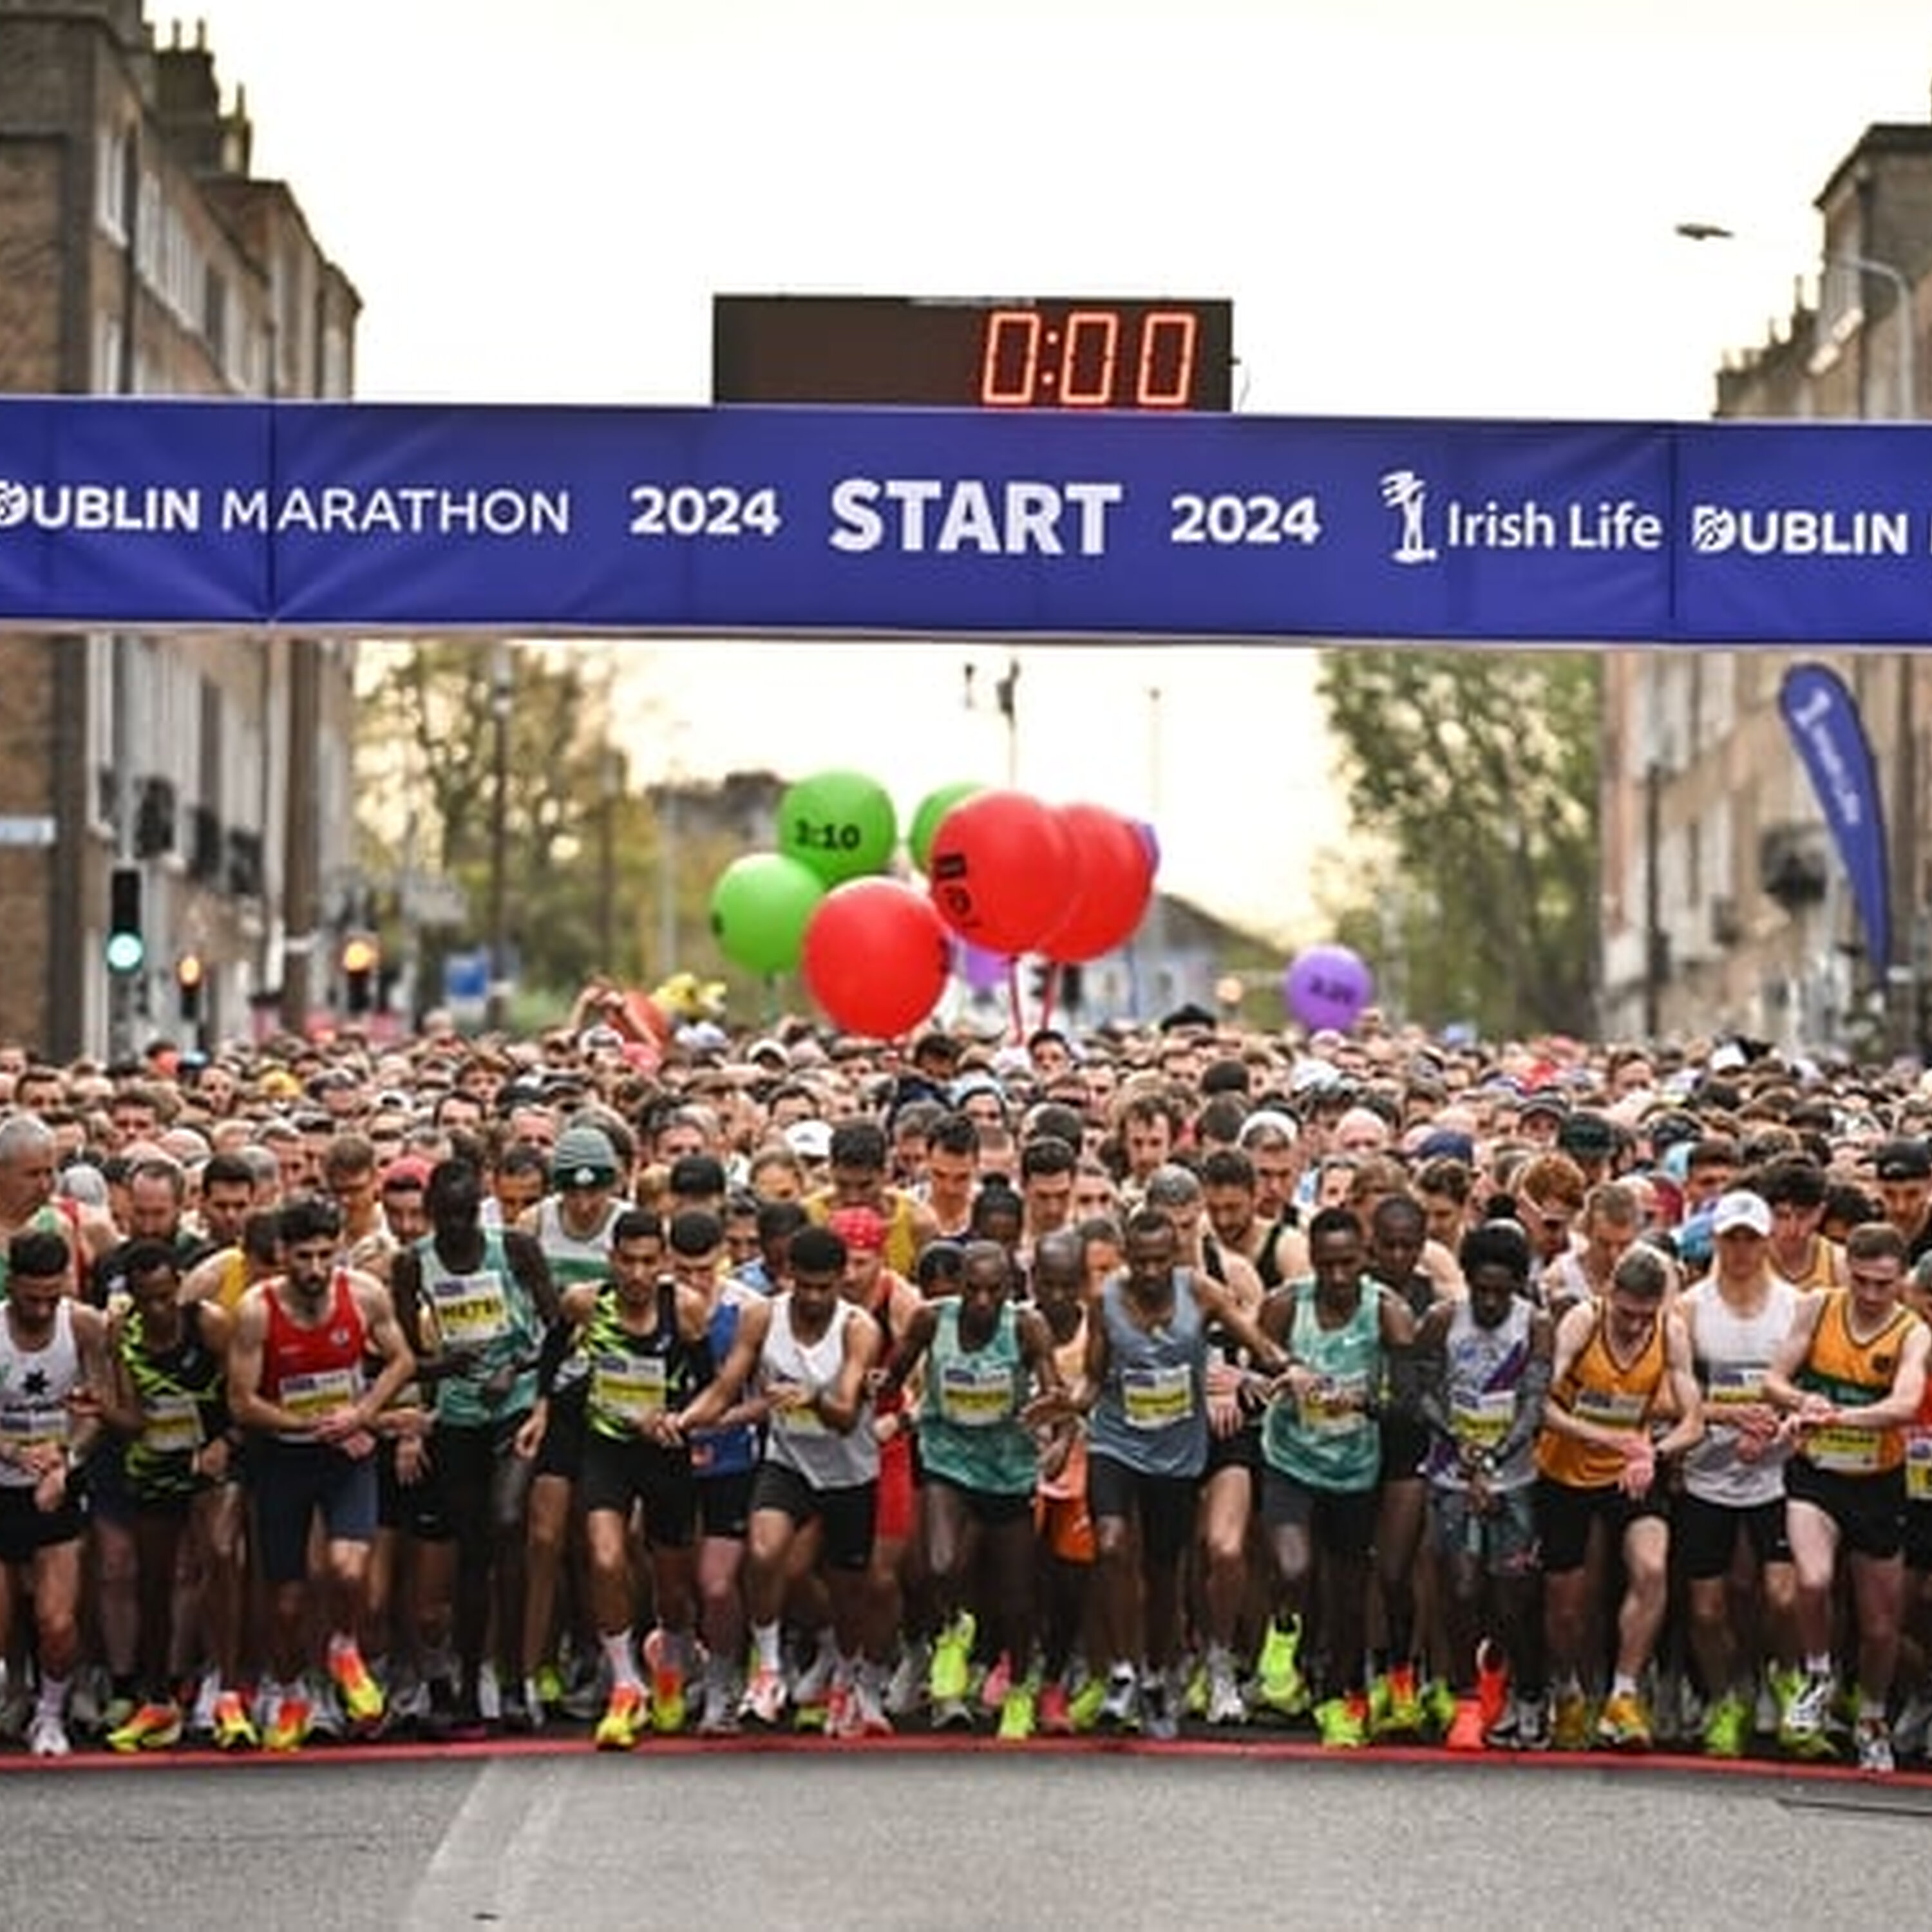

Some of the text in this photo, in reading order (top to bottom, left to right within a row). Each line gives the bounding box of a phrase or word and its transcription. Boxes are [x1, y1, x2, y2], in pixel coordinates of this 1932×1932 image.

[981, 312, 1196, 406] 0:00
[0, 480, 569, 534] DUBLIN MARATHON
[630, 478, 1321, 554] 2024 START 2024
[1449, 501, 1662, 549] Irish Life
[1692, 506, 1908, 554] DUBLIN
